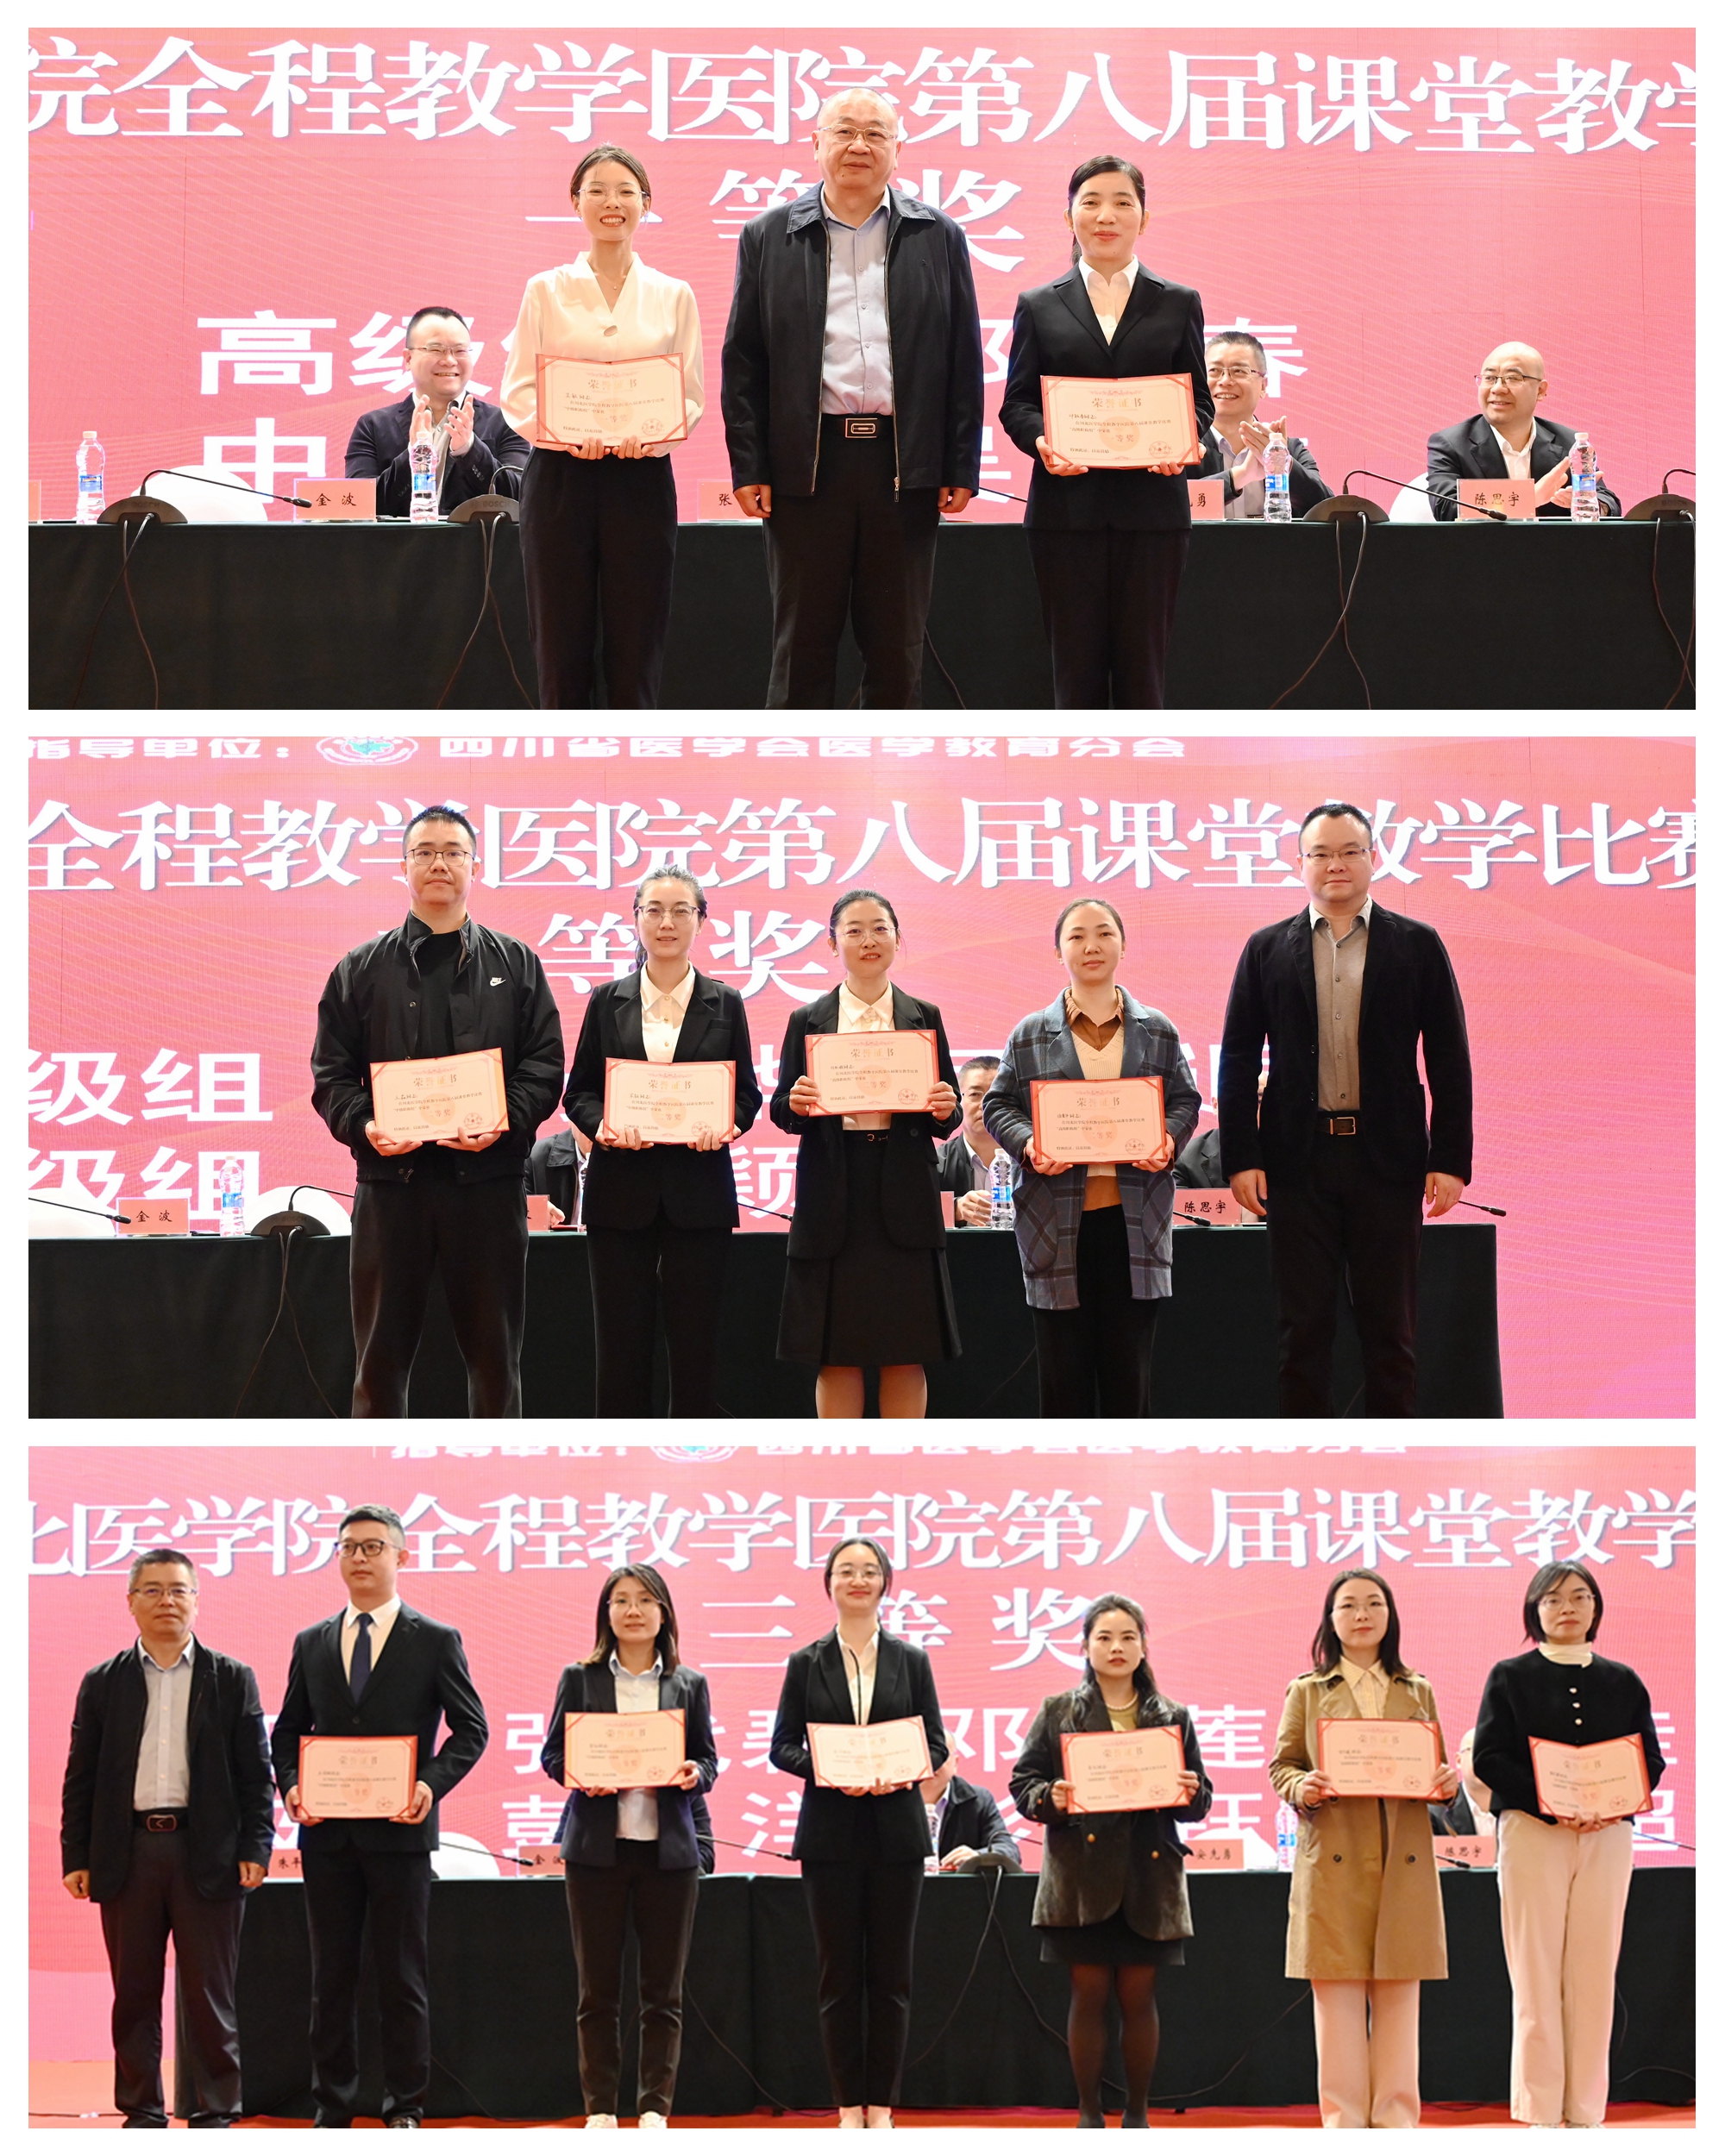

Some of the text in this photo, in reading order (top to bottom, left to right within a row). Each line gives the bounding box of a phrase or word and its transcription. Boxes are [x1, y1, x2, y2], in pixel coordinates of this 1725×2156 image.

[197, 310, 524, 397] 高级
[316, 492, 357, 507] 金波
[1474, 492, 1520, 506] 陈思宇
[440, 737, 1185, 758] 四川省医学会医学教育分会
[28, 1048, 273, 1125] 级组
[1183, 1200, 1226, 1214] 陈思宇
[135, 1209, 172, 1223] 金波
